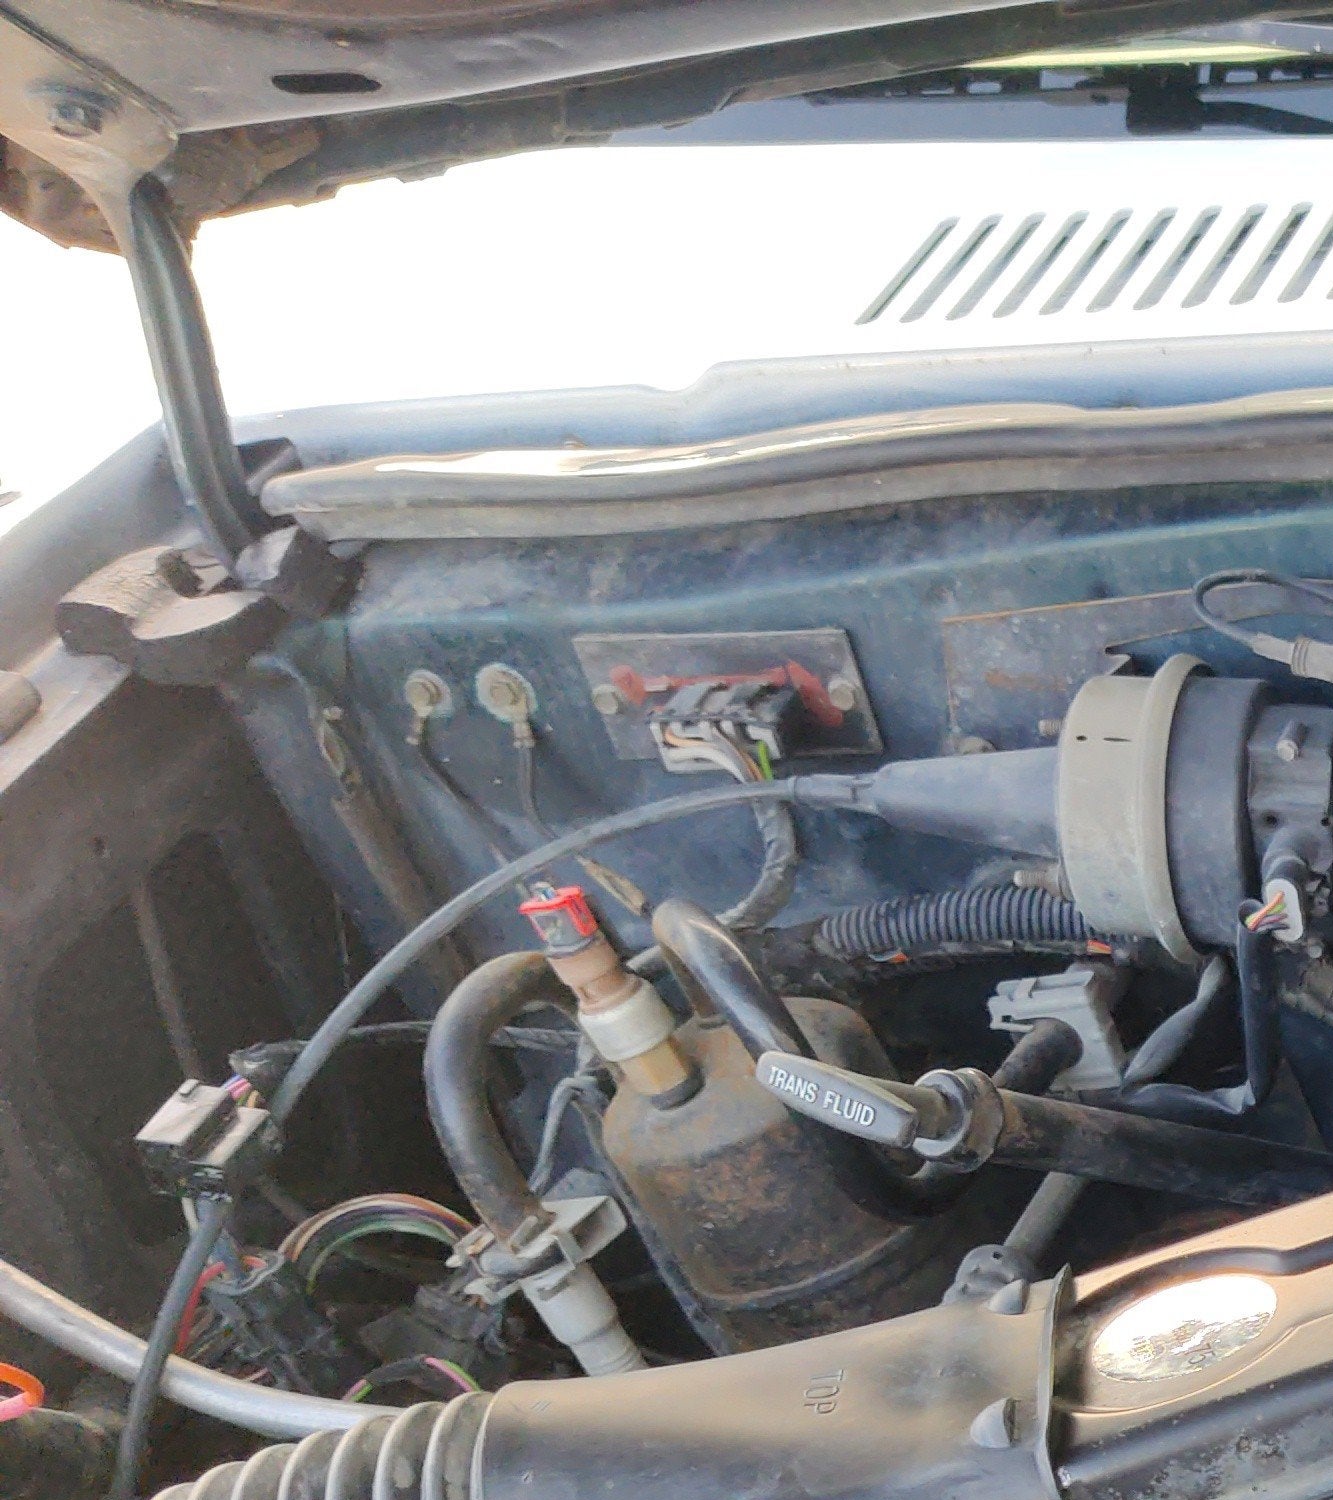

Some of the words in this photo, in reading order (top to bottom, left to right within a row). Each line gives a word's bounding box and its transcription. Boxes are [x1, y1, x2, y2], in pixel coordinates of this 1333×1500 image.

[767, 1065, 819, 1103] TRANS
[822, 1090, 876, 1127] FLUID
[803, 1368, 844, 1415] TOP
